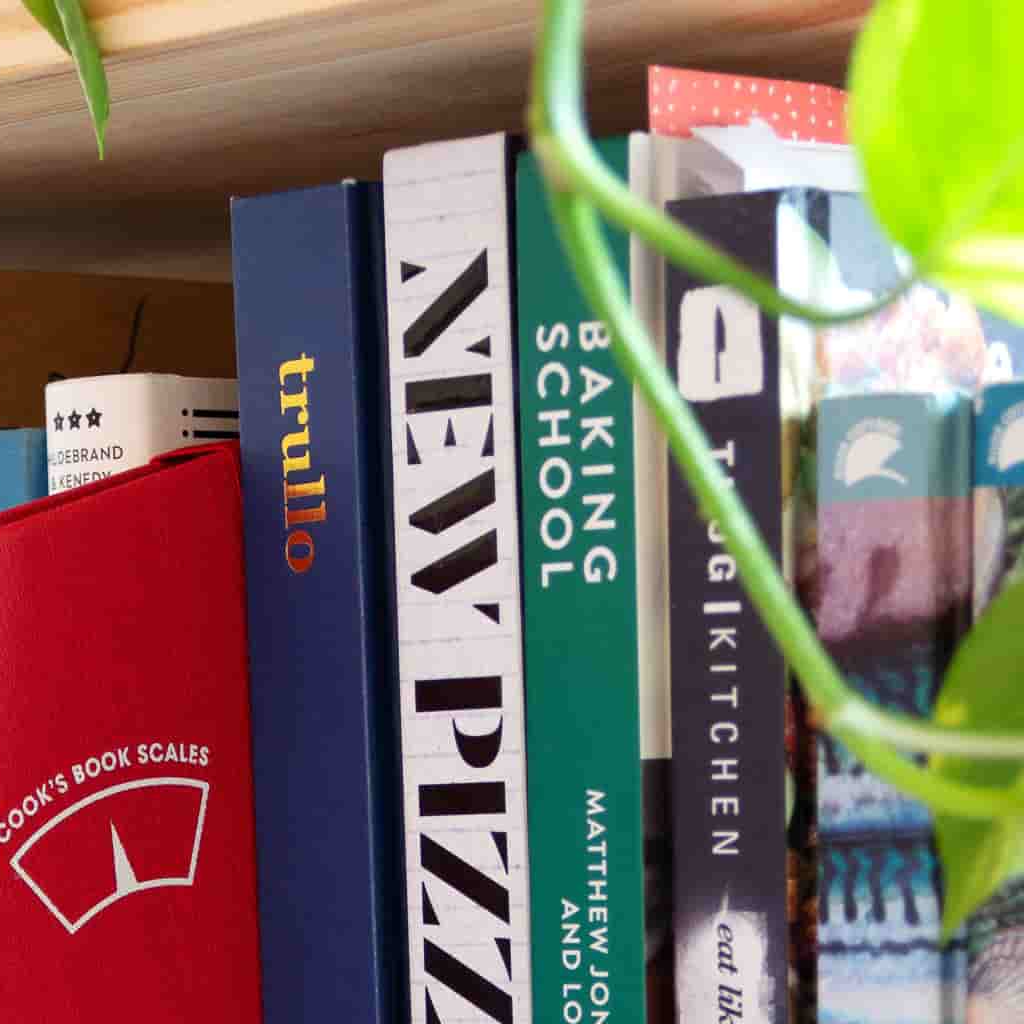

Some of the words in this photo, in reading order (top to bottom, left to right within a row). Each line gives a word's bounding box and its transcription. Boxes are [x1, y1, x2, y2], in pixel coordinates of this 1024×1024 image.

[279, 352, 327, 574] trullo
[400, 248, 500, 625] NEW
[536, 322, 574, 589] SCHOOL
[578, 320, 618, 584] BAKING
[71, 747, 132, 785] BOOK
[137, 742, 210, 767] SCALES
[709, 629, 740, 856] KITCHEN
[561, 898, 582, 970] AND
[586, 789, 609, 955] MATTHEW
[717, 923, 739, 975] eat
